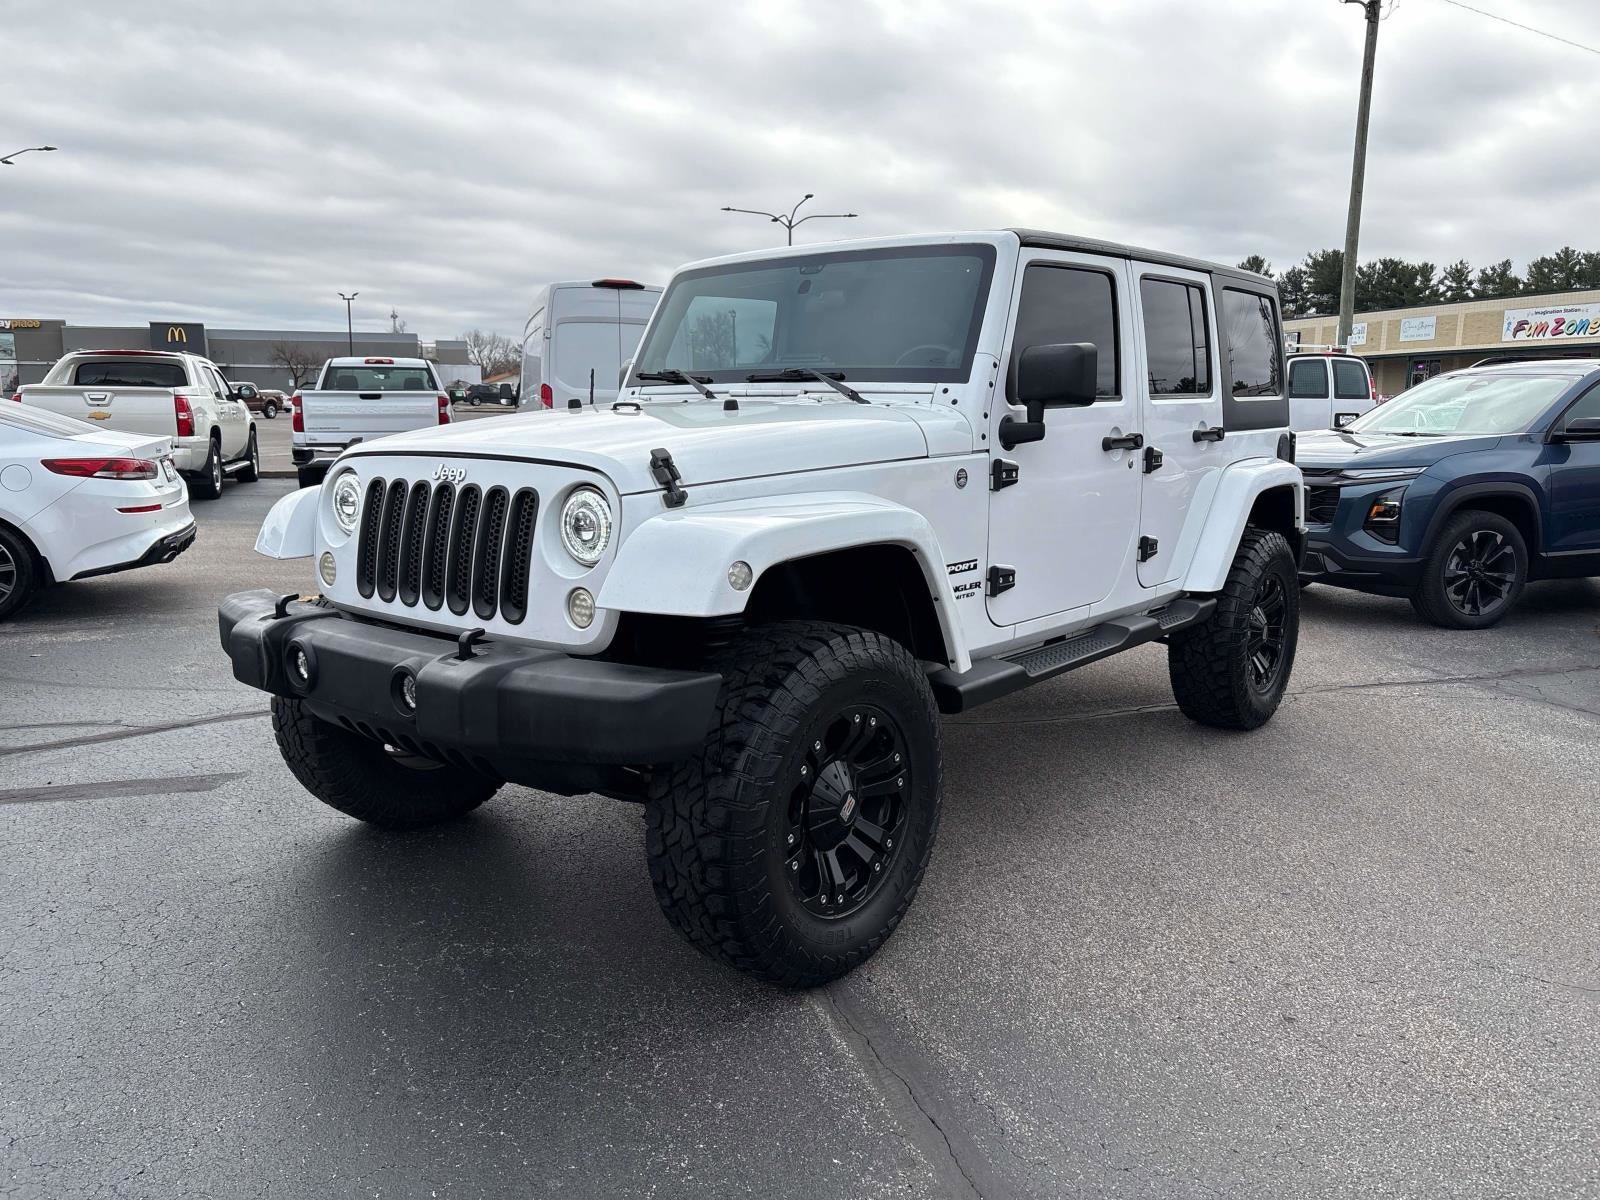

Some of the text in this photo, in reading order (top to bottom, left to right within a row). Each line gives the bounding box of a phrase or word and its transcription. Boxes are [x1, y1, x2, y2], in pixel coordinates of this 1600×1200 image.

[1512, 320, 1549, 339] Fun
[432, 464, 466, 485] Jeep
[948, 562, 975, 572] PORT
